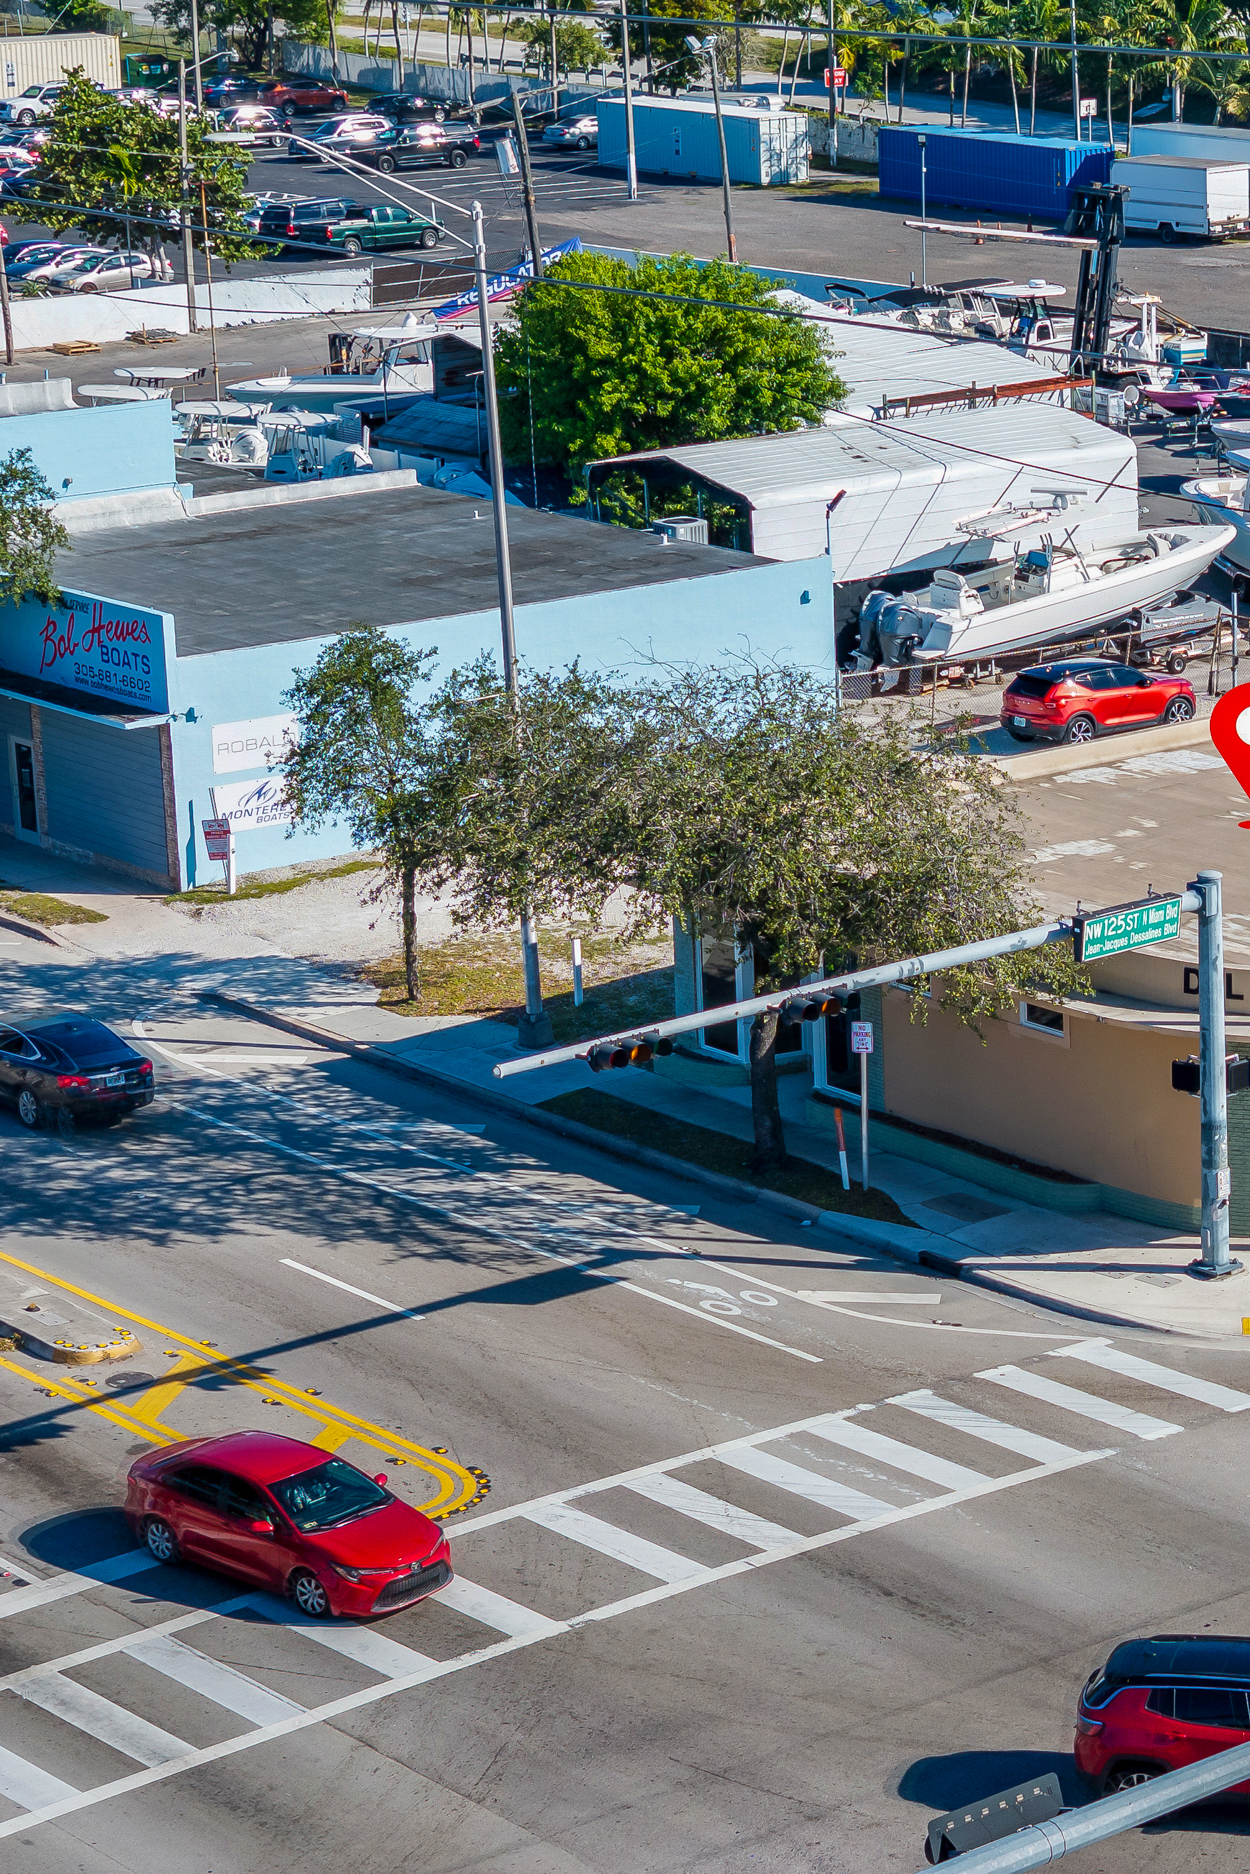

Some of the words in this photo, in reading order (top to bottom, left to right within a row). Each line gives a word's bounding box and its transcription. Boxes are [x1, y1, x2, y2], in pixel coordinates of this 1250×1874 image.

[39, 612, 79, 674] Bob
[82, 602, 151, 652] Hewes
[100, 644, 151, 675] BOATS
[74, 662, 151, 693] 305-681-6602
[217, 732, 296, 755] ROBALO
[221, 801, 296, 820] MONTEREY
[256, 811, 290, 824] BOATS
[1085, 921, 1102, 941] NW
[1104, 914, 1126, 937] 125
[1126, 913, 1140, 931] ST
[1142, 910, 1148, 926] N
[1148, 905, 1165, 925] Miami
[1165, 902, 1179, 920] Blvd
[1085, 936, 1129, 956] Jean-Jacques
[1129, 927, 1162, 944] Dessalines
[1163, 921, 1178, 936] Blvd
[1183, 967, 1245, 1001] DL
